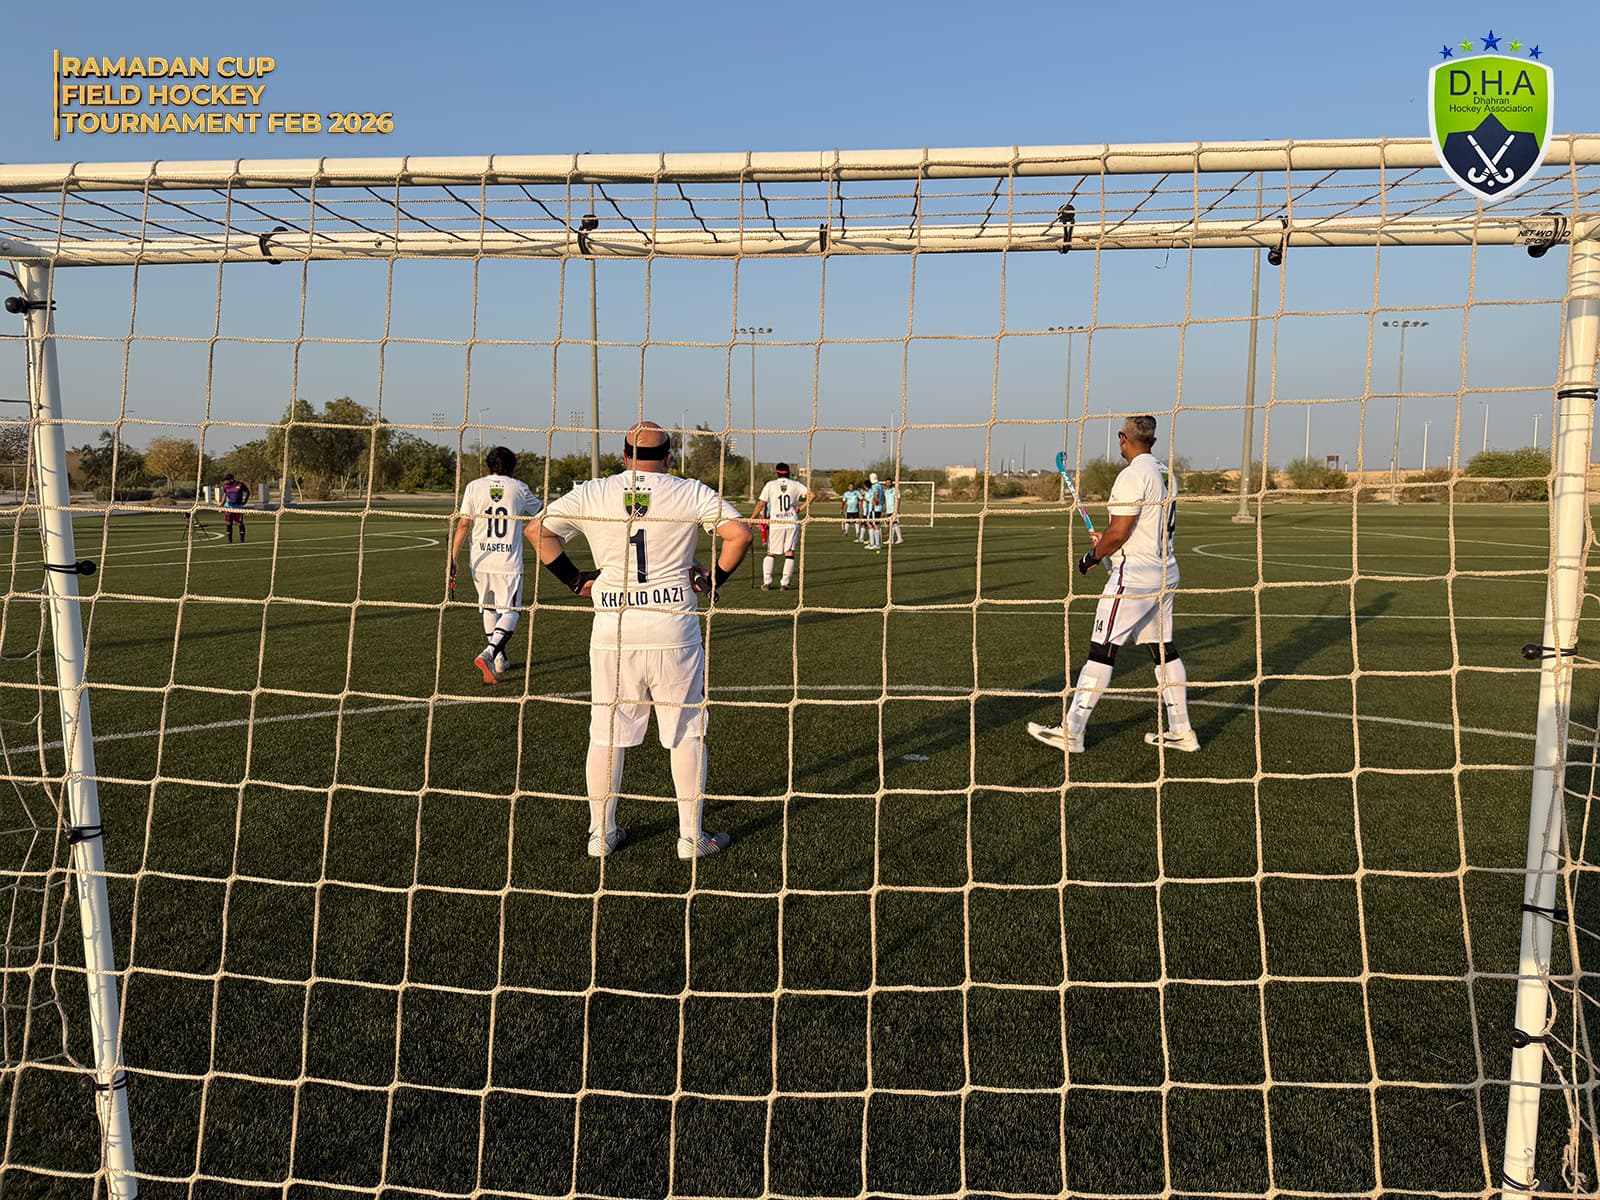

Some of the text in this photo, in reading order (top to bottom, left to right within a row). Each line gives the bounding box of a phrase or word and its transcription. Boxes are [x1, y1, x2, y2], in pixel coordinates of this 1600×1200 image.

[778, 494, 791, 512] 10
[485, 506, 508, 538] 10
[479, 542, 513, 553] WASEEM
[629, 528, 649, 584] 1
[601, 586, 684, 608] KHALID QAZI
[1095, 619, 1104, 633] 14
